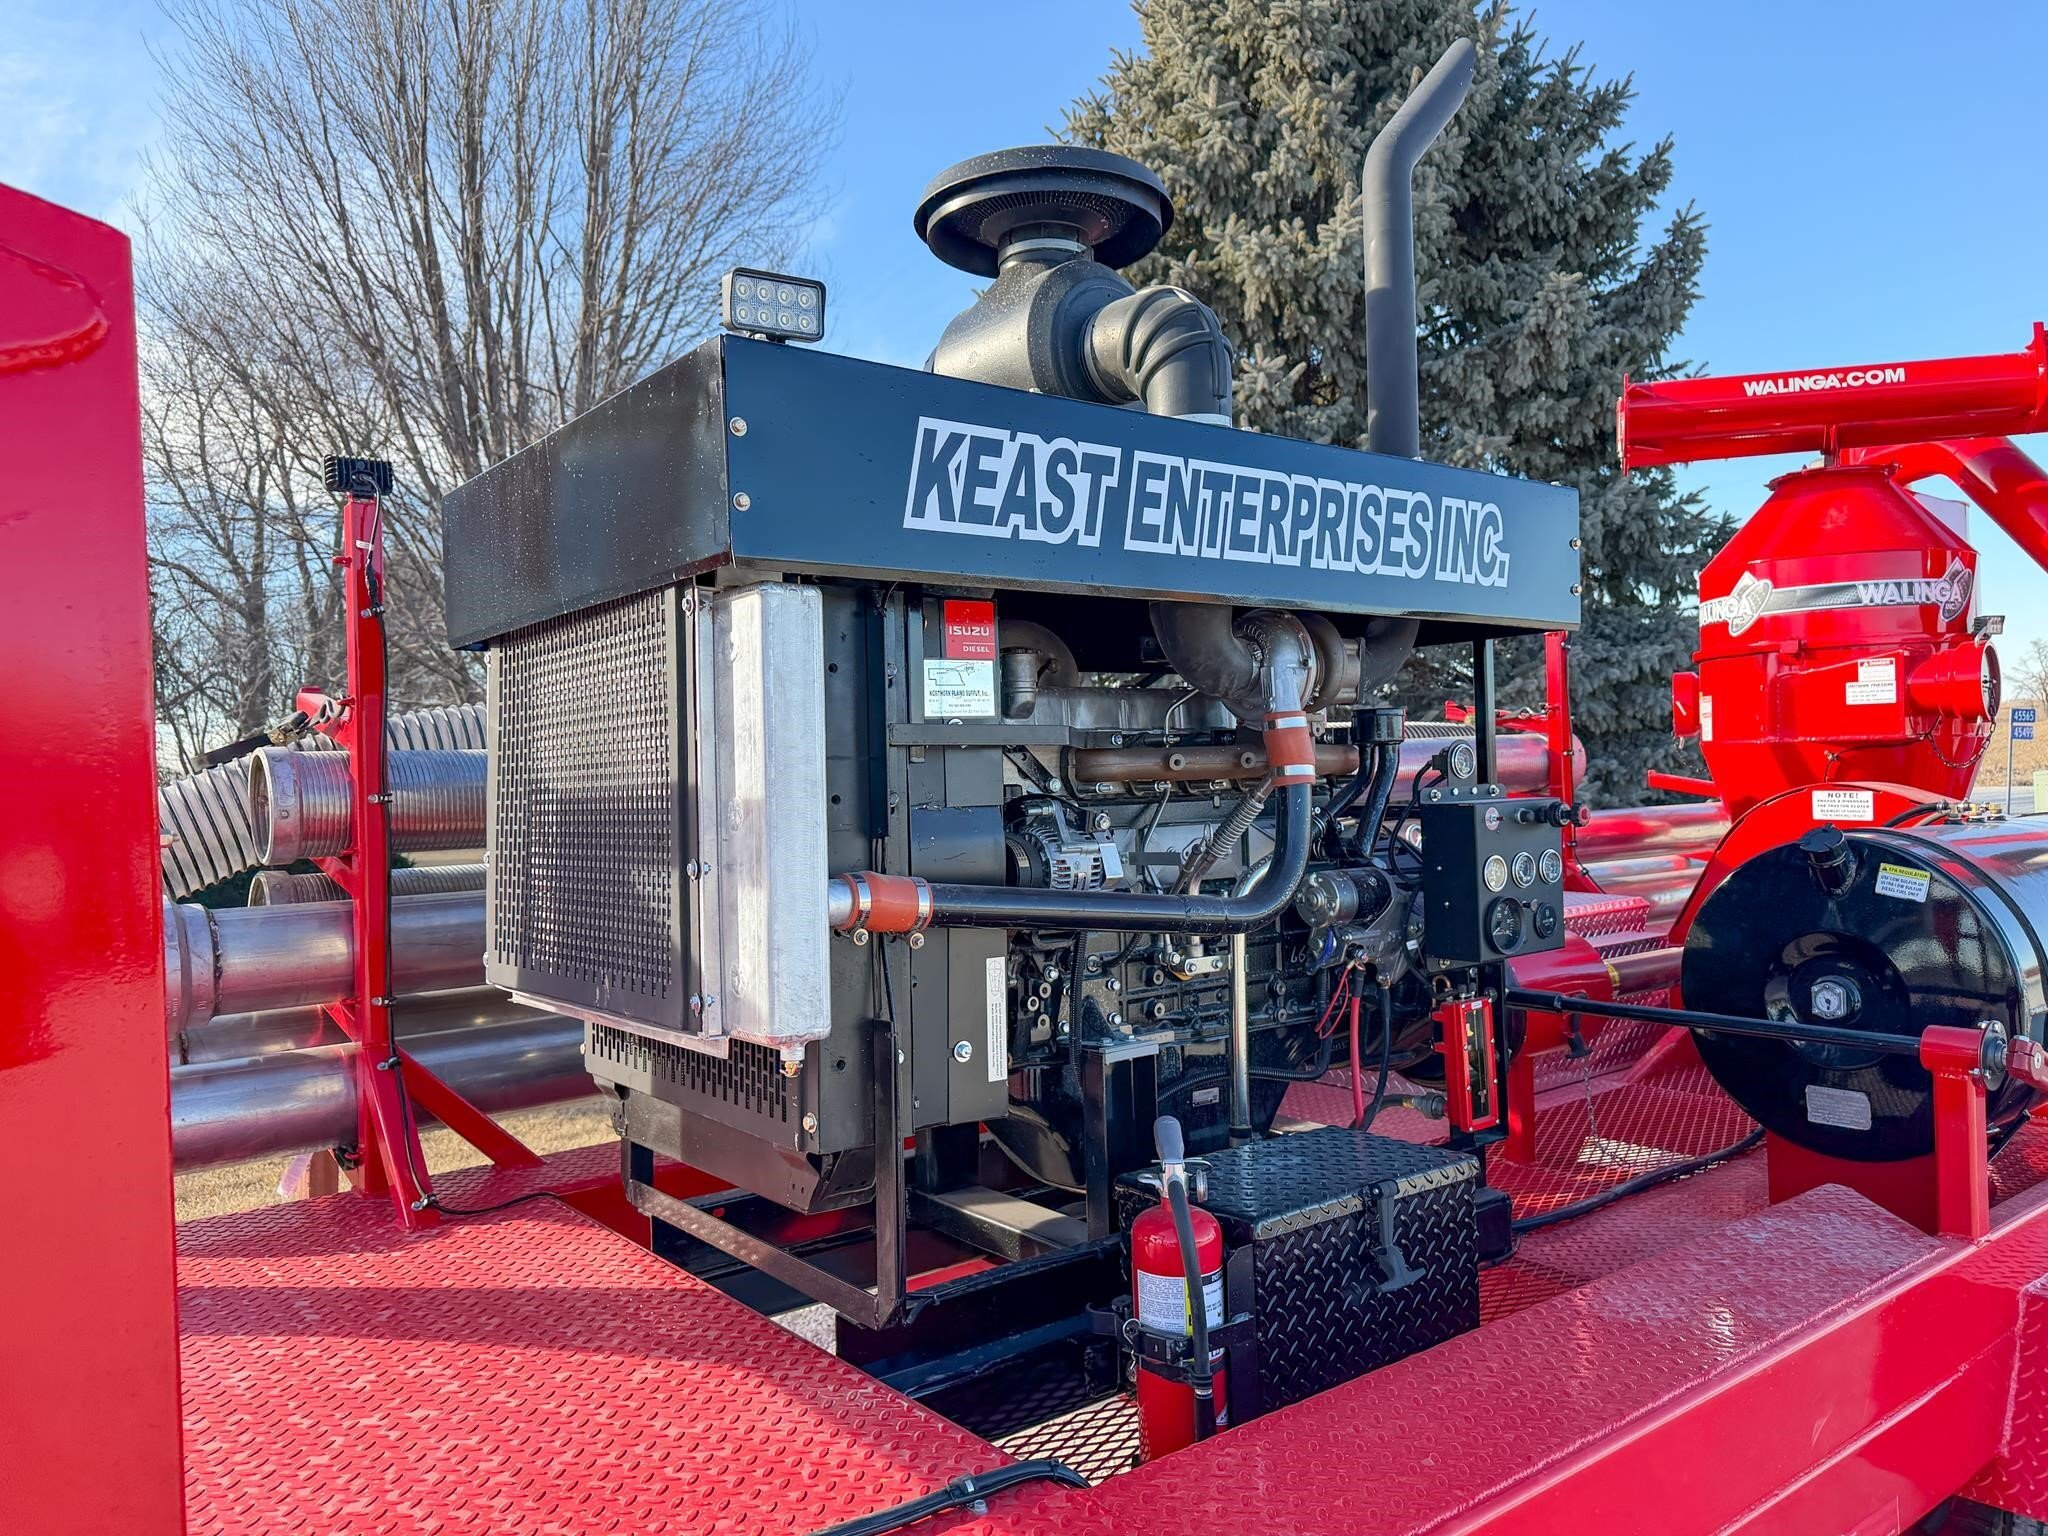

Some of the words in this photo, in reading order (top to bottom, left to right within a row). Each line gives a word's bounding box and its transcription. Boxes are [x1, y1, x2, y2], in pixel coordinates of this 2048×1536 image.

[903, 416, 1121, 547] KEAST
[1124, 450, 1433, 579] ENTERPRISES
[1435, 497, 1510, 587] INC.
[1856, 579, 1962, 605] WALINGA
[1699, 596, 1755, 626] ALINGA
[949, 625, 989, 636] ISUZU
